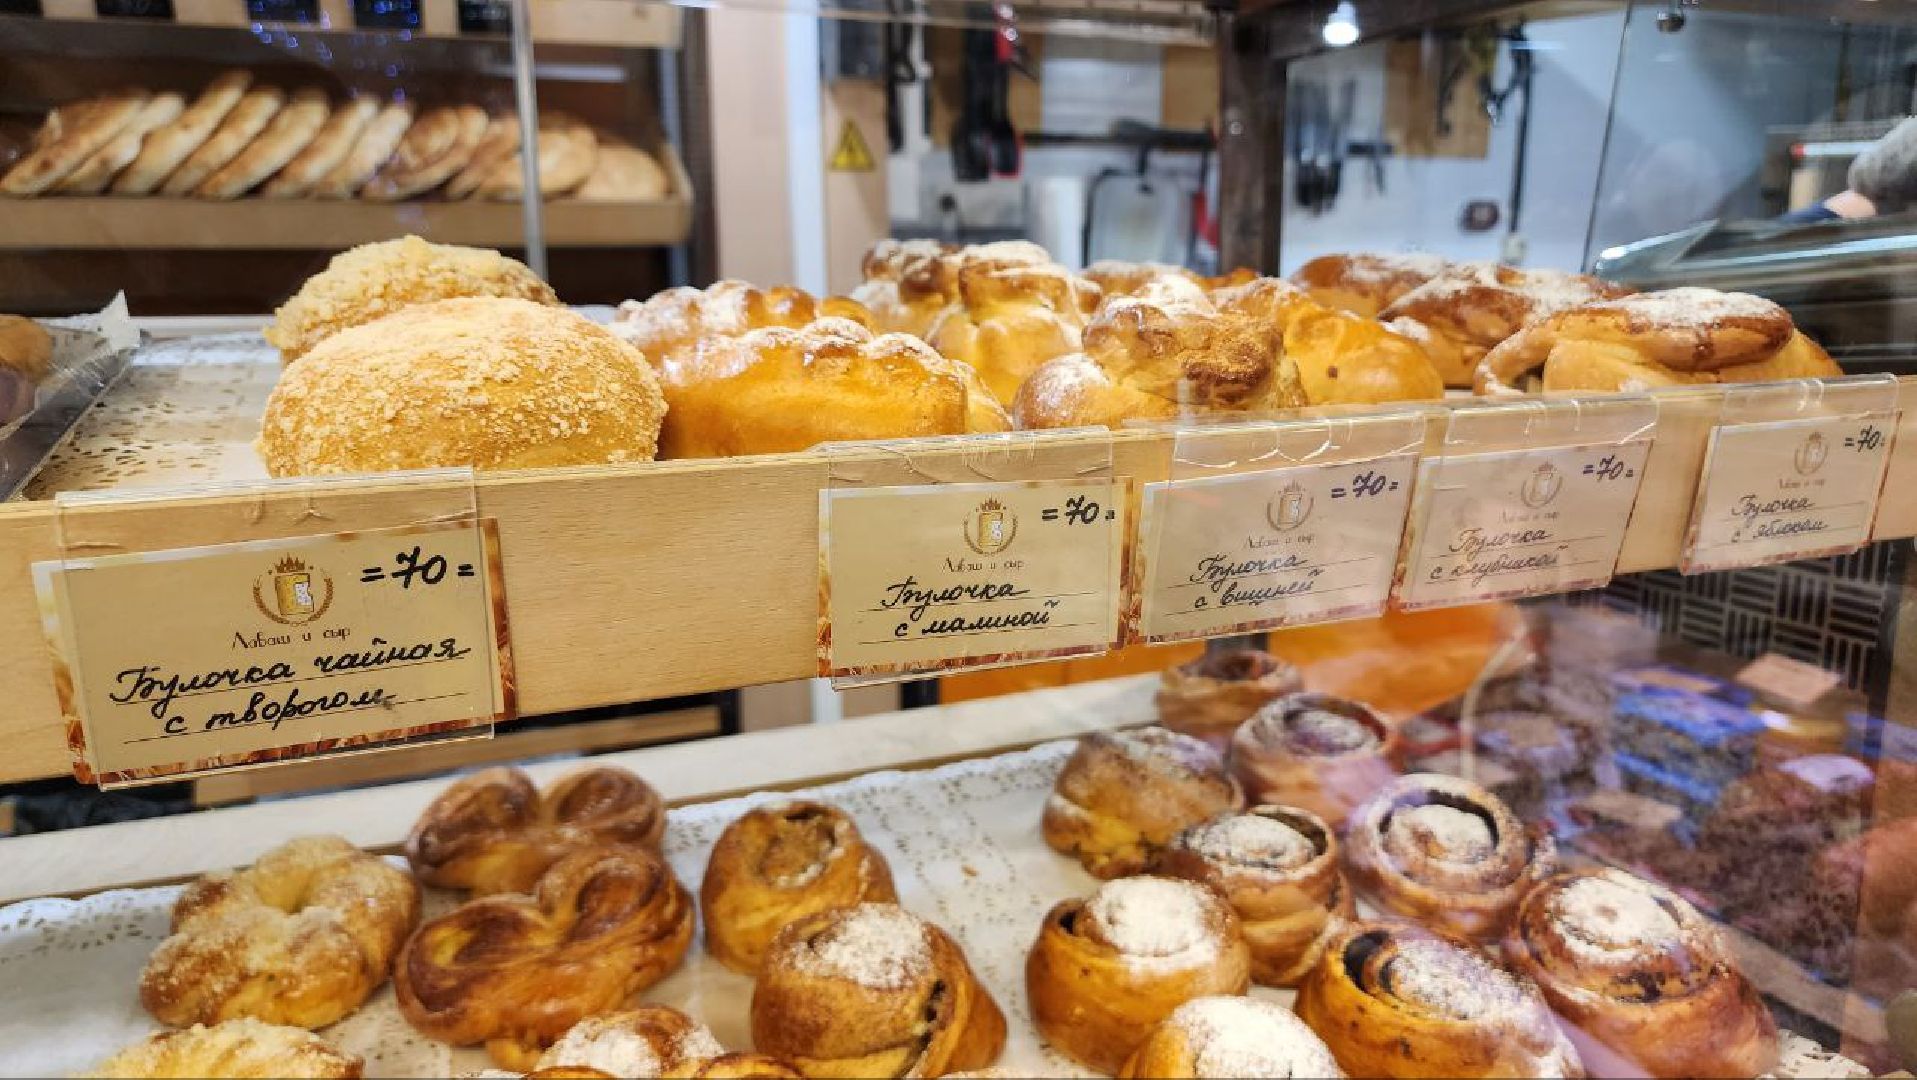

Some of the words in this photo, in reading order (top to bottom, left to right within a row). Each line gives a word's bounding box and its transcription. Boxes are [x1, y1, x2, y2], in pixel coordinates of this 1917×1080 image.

[1731, 494, 1815, 528] Булочка
[1449, 527, 1554, 561] Булочка
[1190, 553, 1308, 592] Булочка
[1195, 596, 1207, 608] с
[1221, 567, 1325, 605] вишней
[1430, 566, 1442, 579] с
[880, 576, 1031, 621] Булочка
[895, 622, 908, 637] с
[922, 599, 1060, 635] малиной
[232, 632, 291, 650] Лаваш
[302, 632, 311, 641] и
[323, 628, 350, 641] сыр
[109, 662, 295, 717] Булочка
[314, 638, 472, 673] чайная
[165, 714, 187, 734] с
[205, 688, 397, 731] творогом
